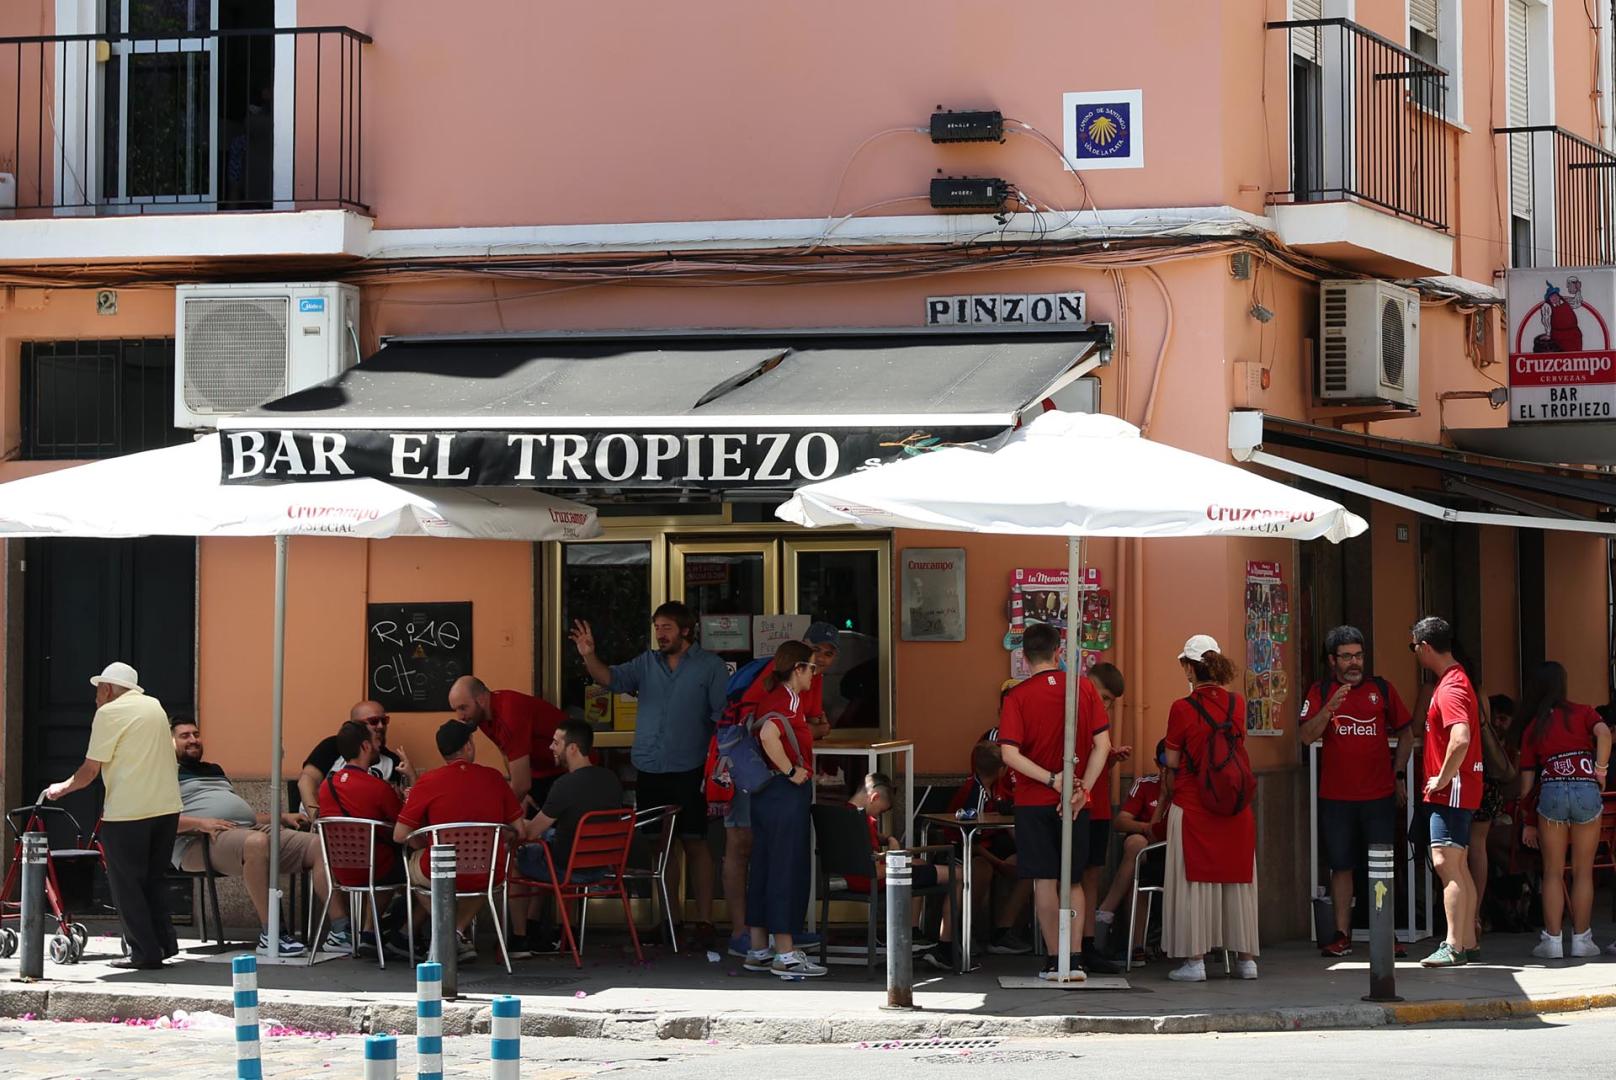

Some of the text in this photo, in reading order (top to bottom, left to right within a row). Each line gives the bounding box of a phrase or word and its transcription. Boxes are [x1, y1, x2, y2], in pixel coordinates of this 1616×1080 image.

[929, 296, 1082, 324] PINZON
[1516, 357, 1611, 375] Cruzcampo
[1550, 388, 1577, 401] BAR
[1520, 402, 1610, 418] EL TROPIEZO
[227, 431, 839, 481] BAR EL TROPIEZO
